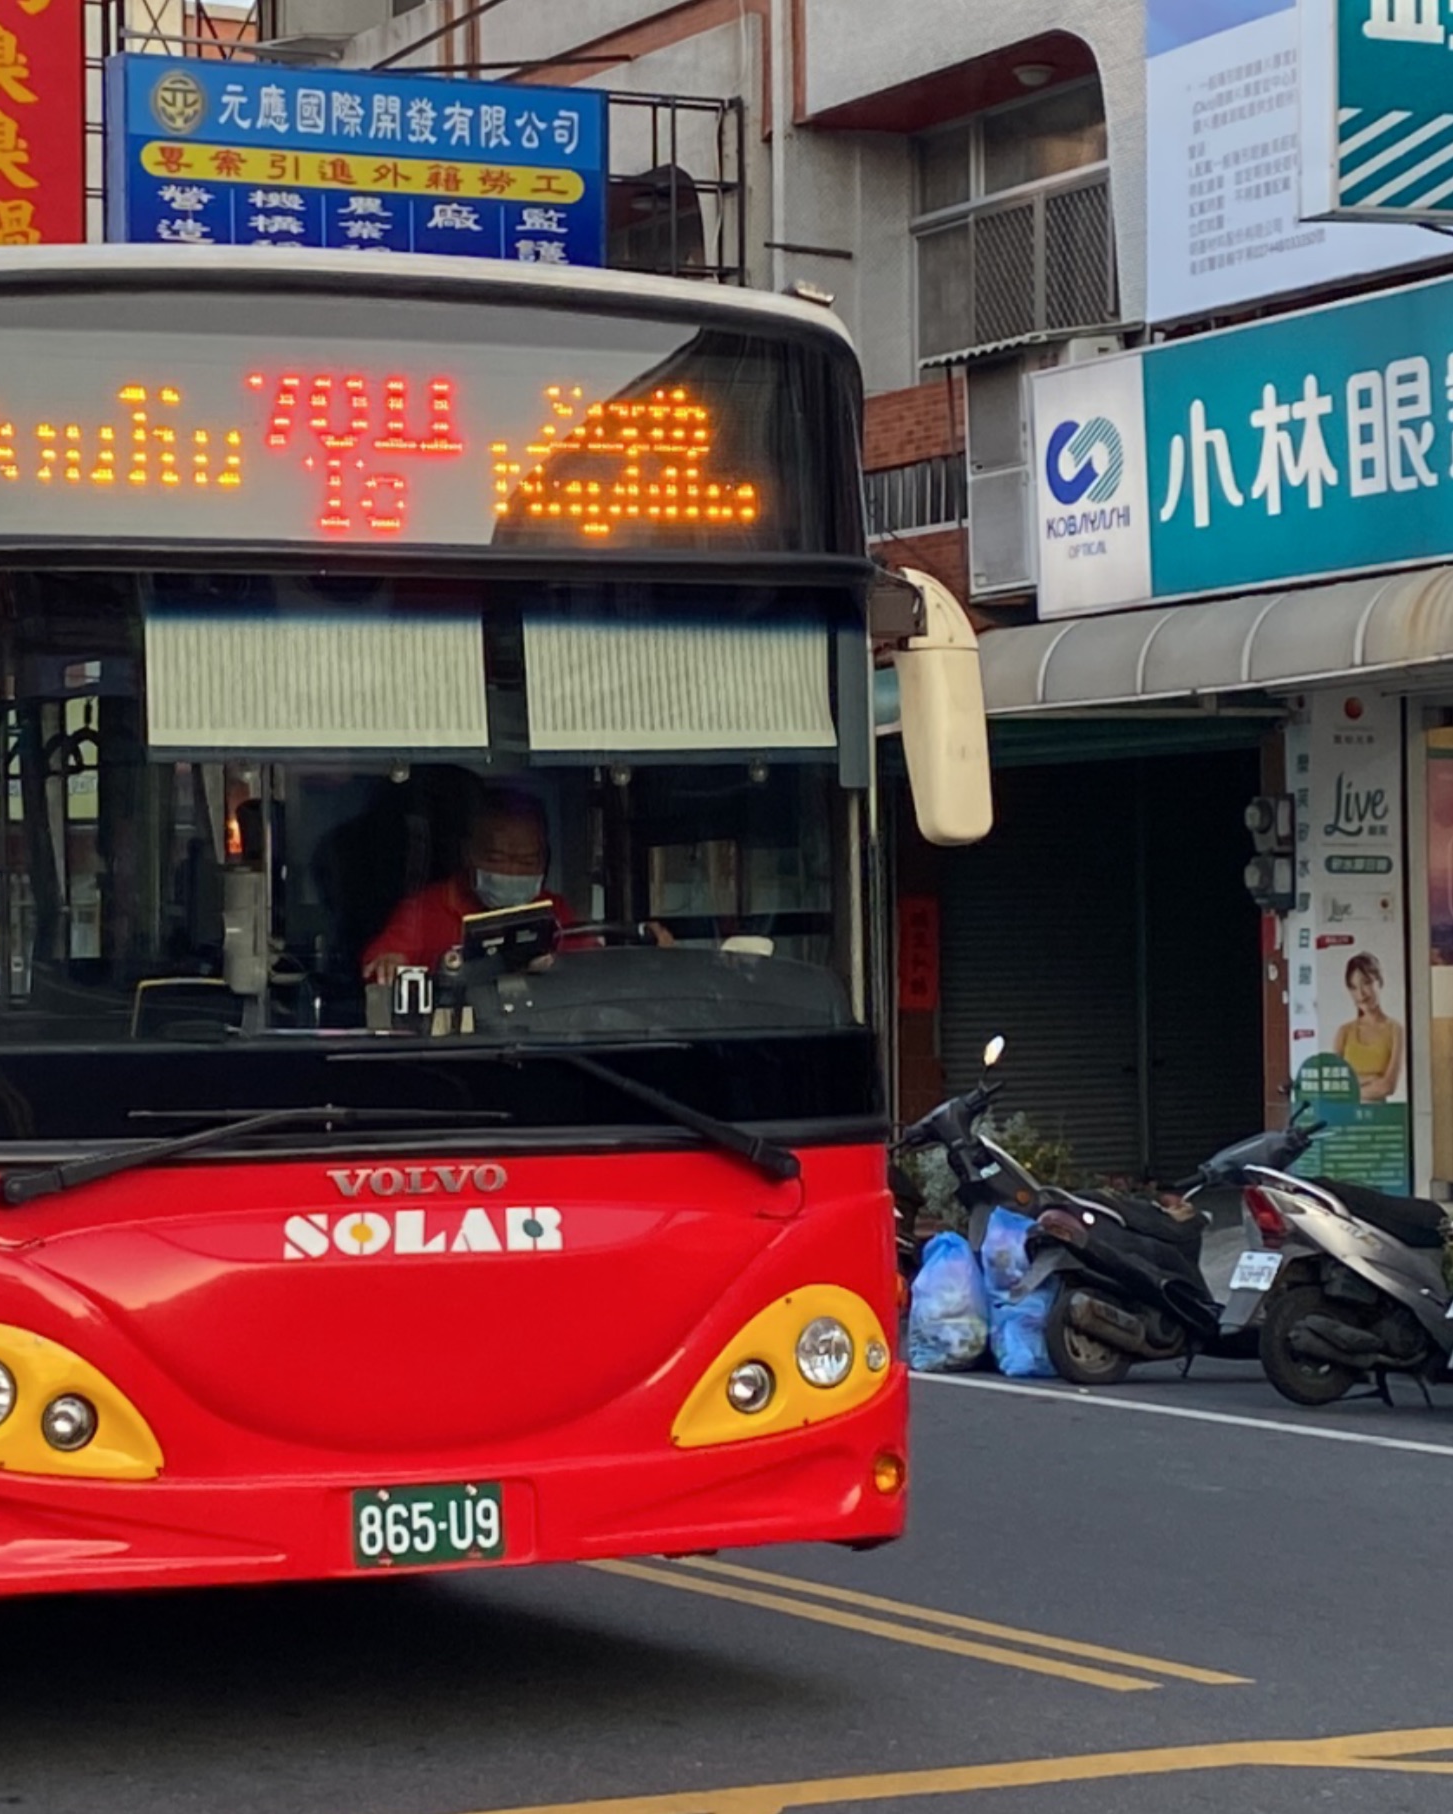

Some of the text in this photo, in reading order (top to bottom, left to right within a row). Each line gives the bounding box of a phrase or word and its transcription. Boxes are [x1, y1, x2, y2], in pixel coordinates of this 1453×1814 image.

[218, 83, 581, 155] 元應國際開發有限公司
[247, 190, 307, 247] 機構
[337, 197, 393, 252] 農業
[1159, 353, 1453, 528] 小林眼
[1046, 504, 1131, 539] KOBAYASHI
[1324, 771, 1389, 837] Live
[326, 1163, 509, 1197] VOLVO
[283, 1206, 564, 1260] SOLAR
[359, 1498, 500, 1557] 865-U9
